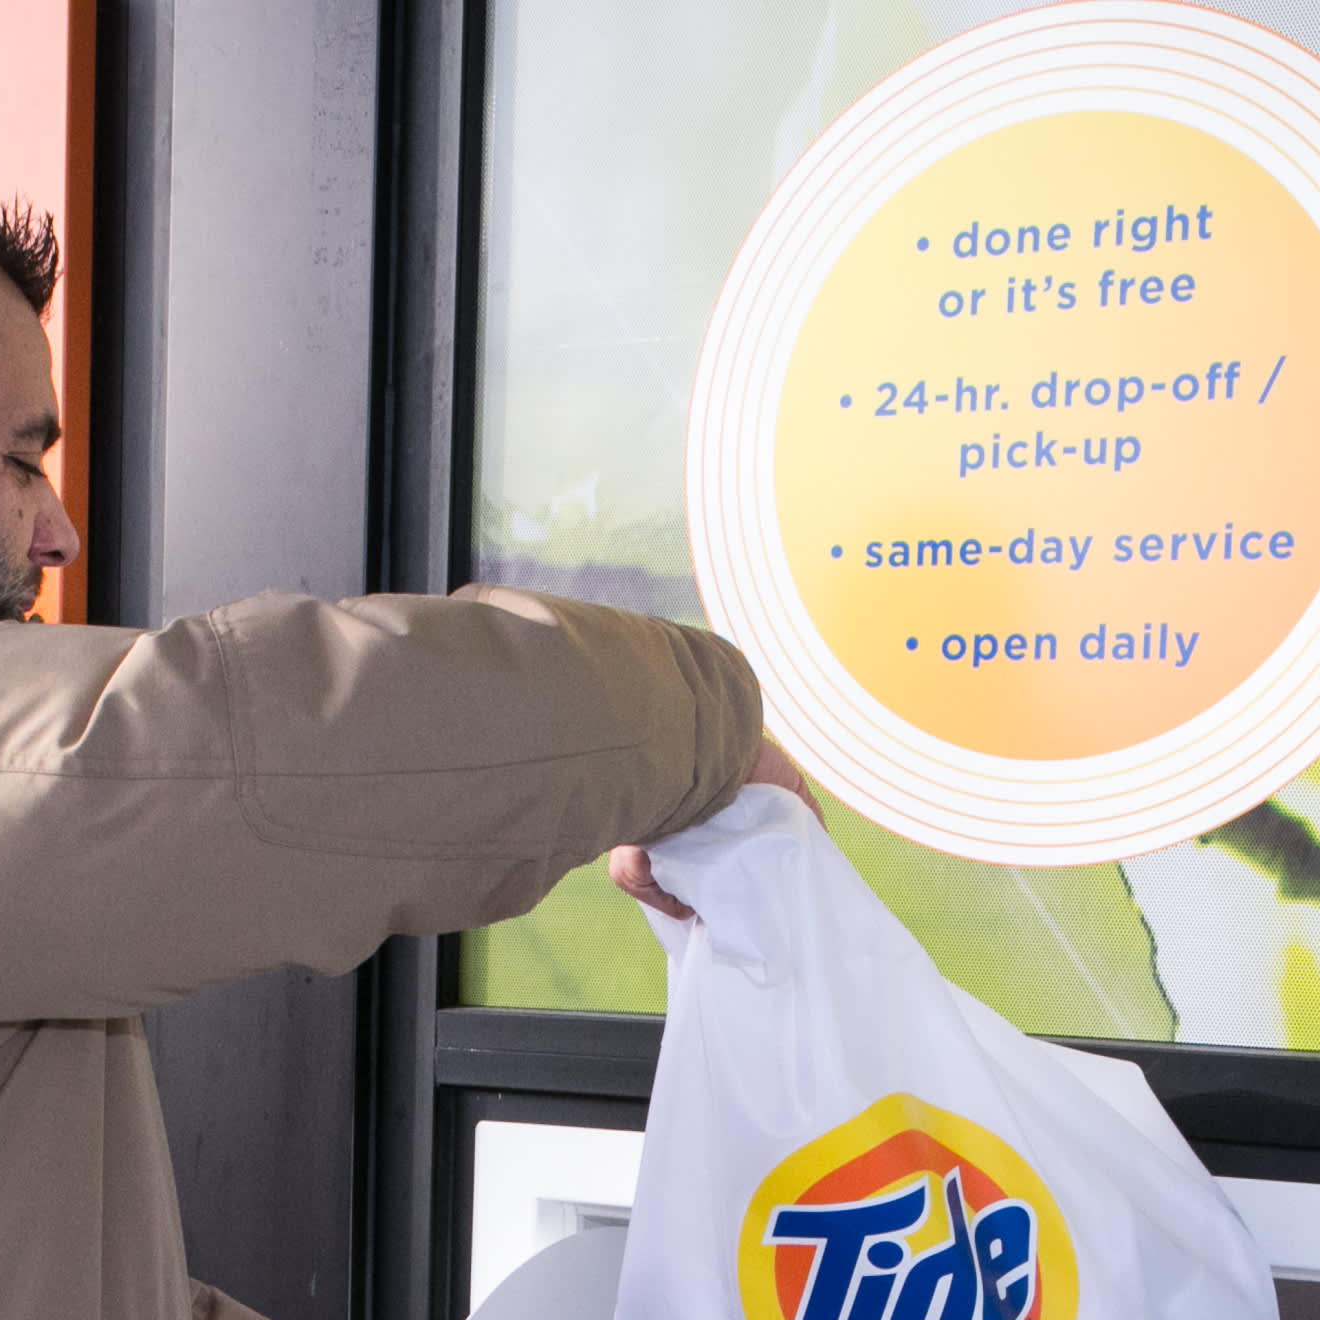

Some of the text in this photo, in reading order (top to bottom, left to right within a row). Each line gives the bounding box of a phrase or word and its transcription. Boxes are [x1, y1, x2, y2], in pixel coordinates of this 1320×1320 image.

[953, 205, 1214, 258] done right
[938, 269, 1196, 317] or it's free
[874, 377, 1009, 417] 24-hr.
[1031, 361, 1241, 412] drop-off
[959, 431, 1142, 478] pick-up
[865, 523, 1295, 571] same-day service
[941, 623, 1199, 668] open daily
